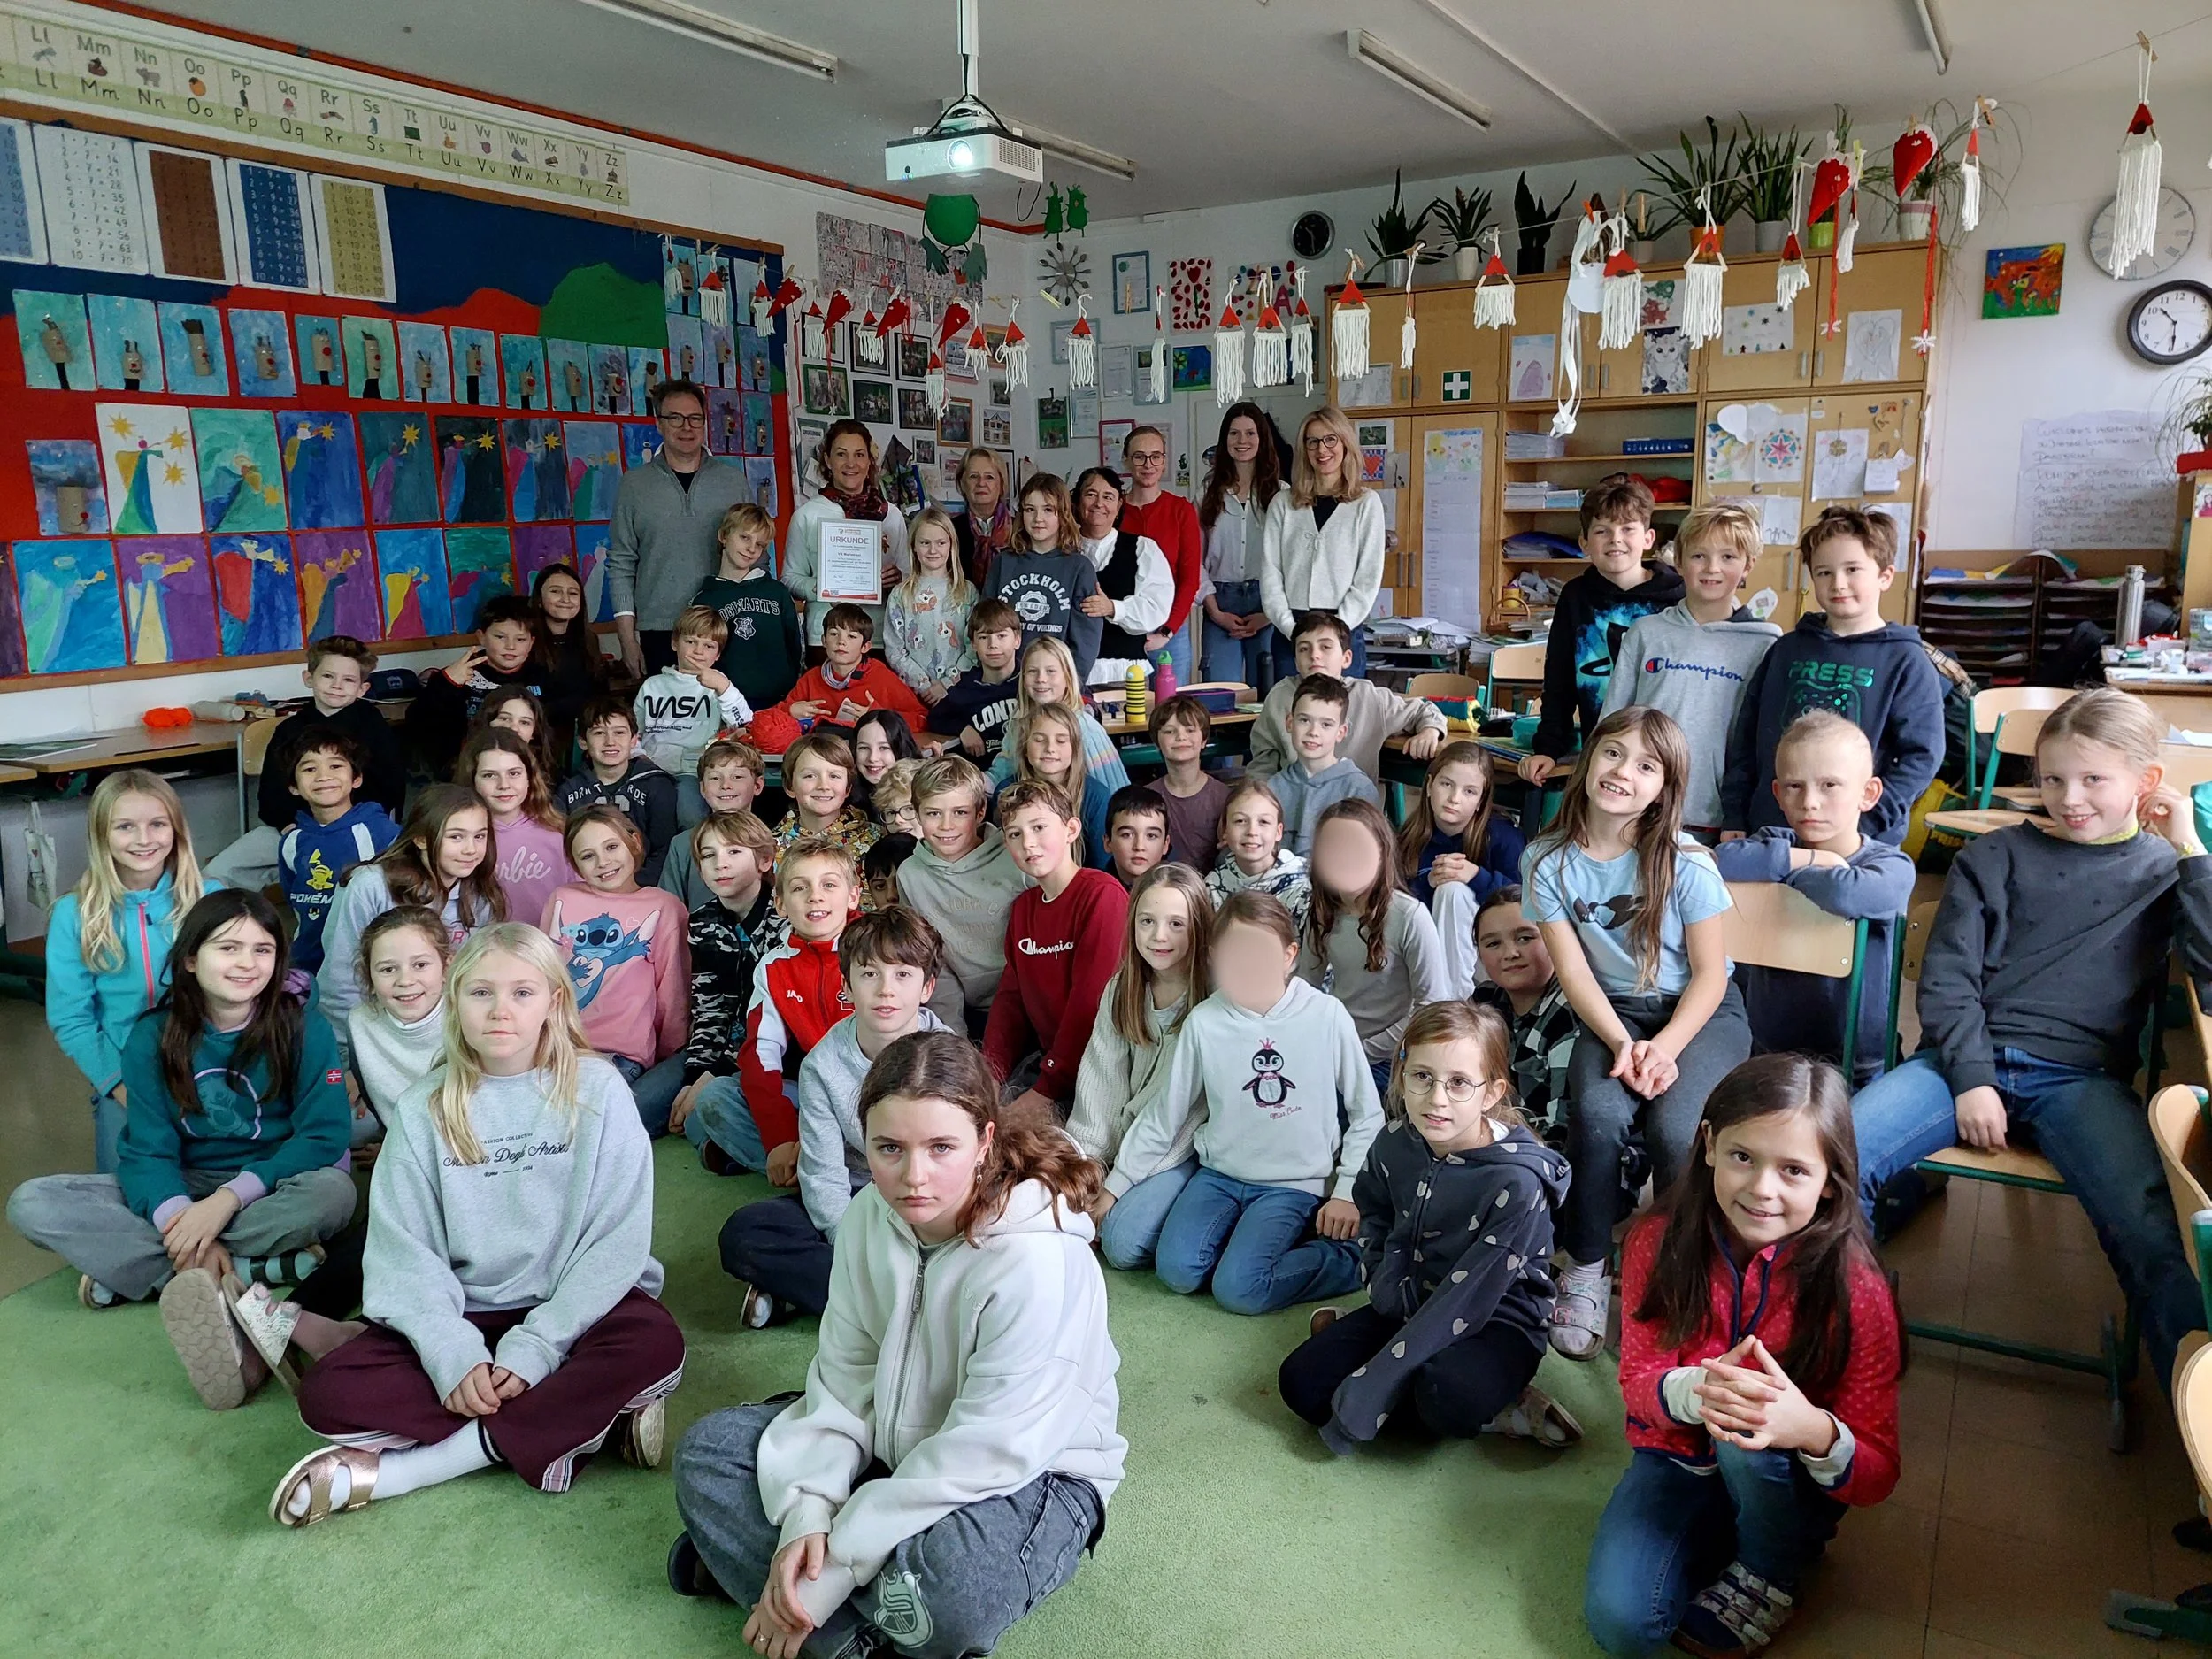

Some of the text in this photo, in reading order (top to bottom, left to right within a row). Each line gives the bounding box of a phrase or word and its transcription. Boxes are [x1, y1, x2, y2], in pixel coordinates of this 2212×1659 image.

[31, 25, 617, 167] Ll Mm Nn Oo Pp Qq Rr Ss Tt Uu Vv Ww Xx Yy Zz
[830, 536, 869, 544] URKUNDE
[718, 597, 780, 622] OGWARTS
[1027, 623, 1036, 631] OF
[1037, 624, 1062, 632] VIKINGS
[1645, 657, 1745, 682] Champion
[1788, 661, 1874, 687] PRESS
[644, 694, 711, 718] NASA
[972, 698, 1019, 732] LOND
[568, 787, 591, 804] BORN
[498, 846, 551, 883] rbie
[1018, 937, 1074, 960] Champio
